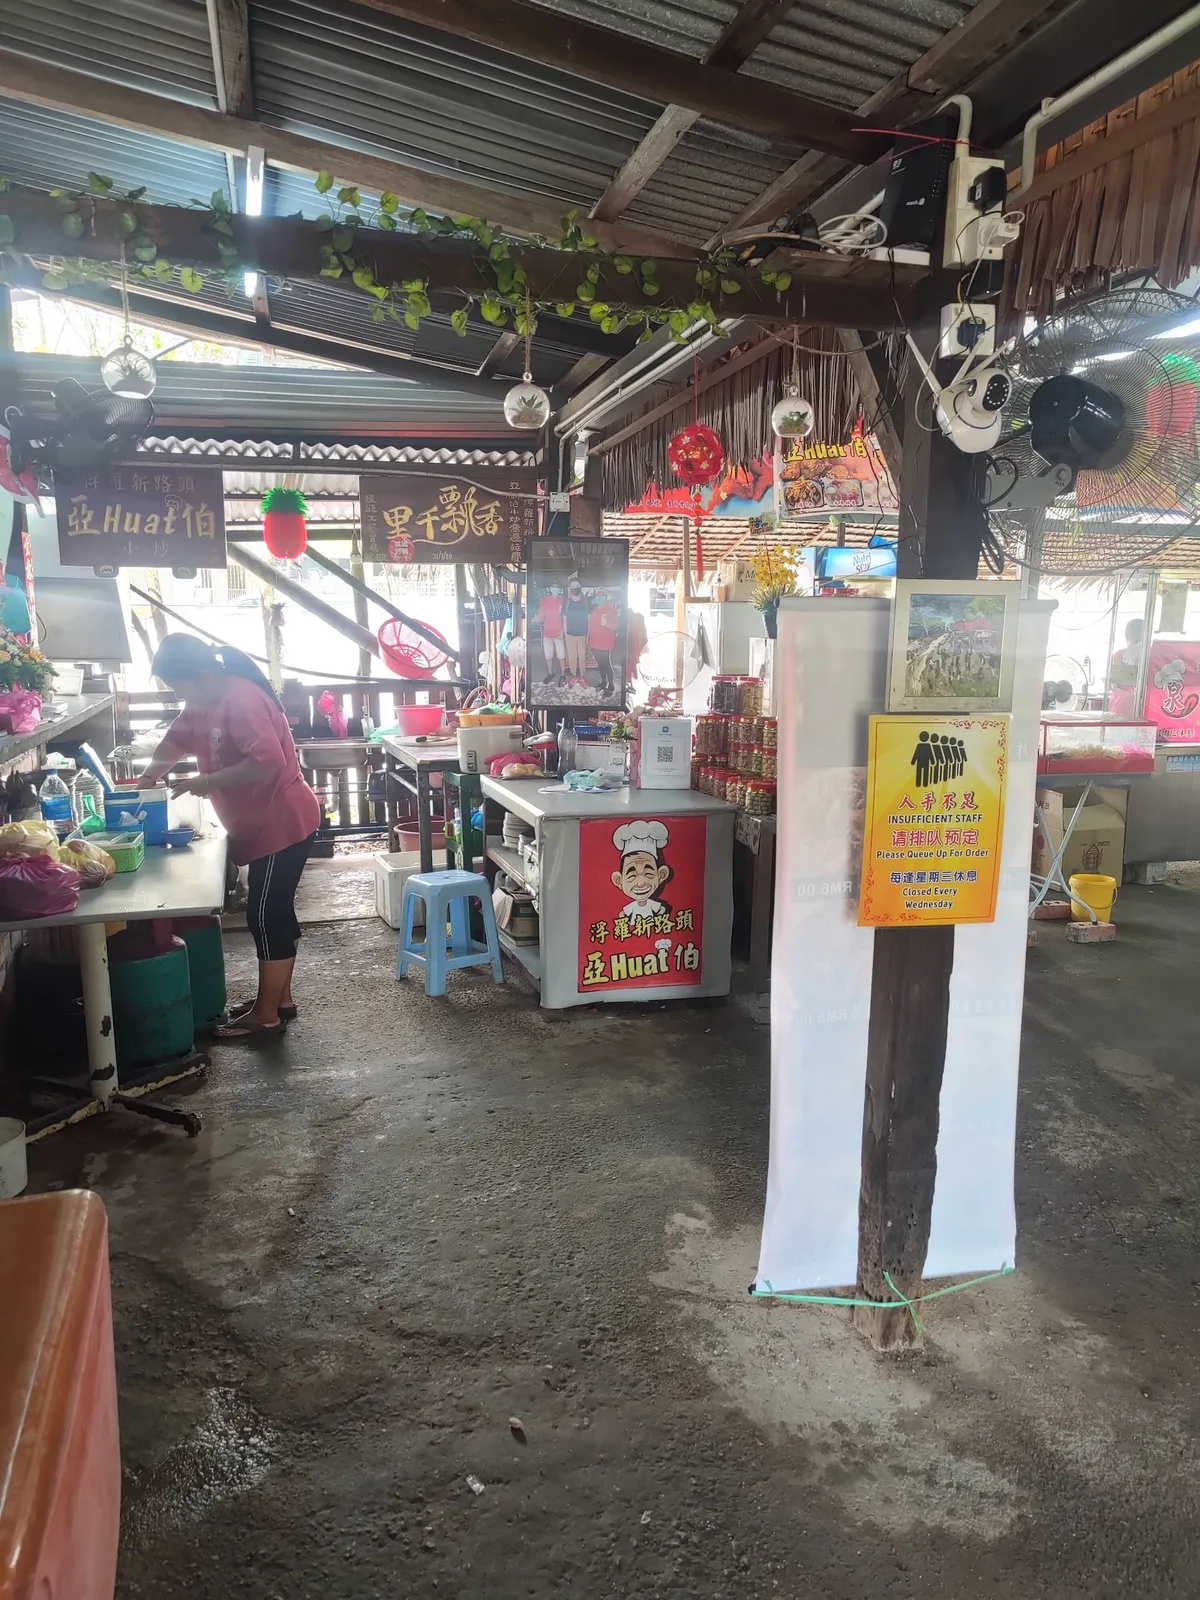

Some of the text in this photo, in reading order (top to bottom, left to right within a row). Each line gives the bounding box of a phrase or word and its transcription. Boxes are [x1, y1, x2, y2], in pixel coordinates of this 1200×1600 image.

[897, 791, 979, 811] 人手不足
[888, 814, 983, 824] INSUFFICIENT STAFF
[891, 829, 980, 847] 请排队预定
[876, 848, 989, 860] Please Queue Up For Order
[890, 871, 978, 884] 每逢星期三休息
[902, 886, 958, 898] Closed Every
[905, 900, 953, 910] Wednesday
[590, 908, 694, 944] 浮羅新路頭
